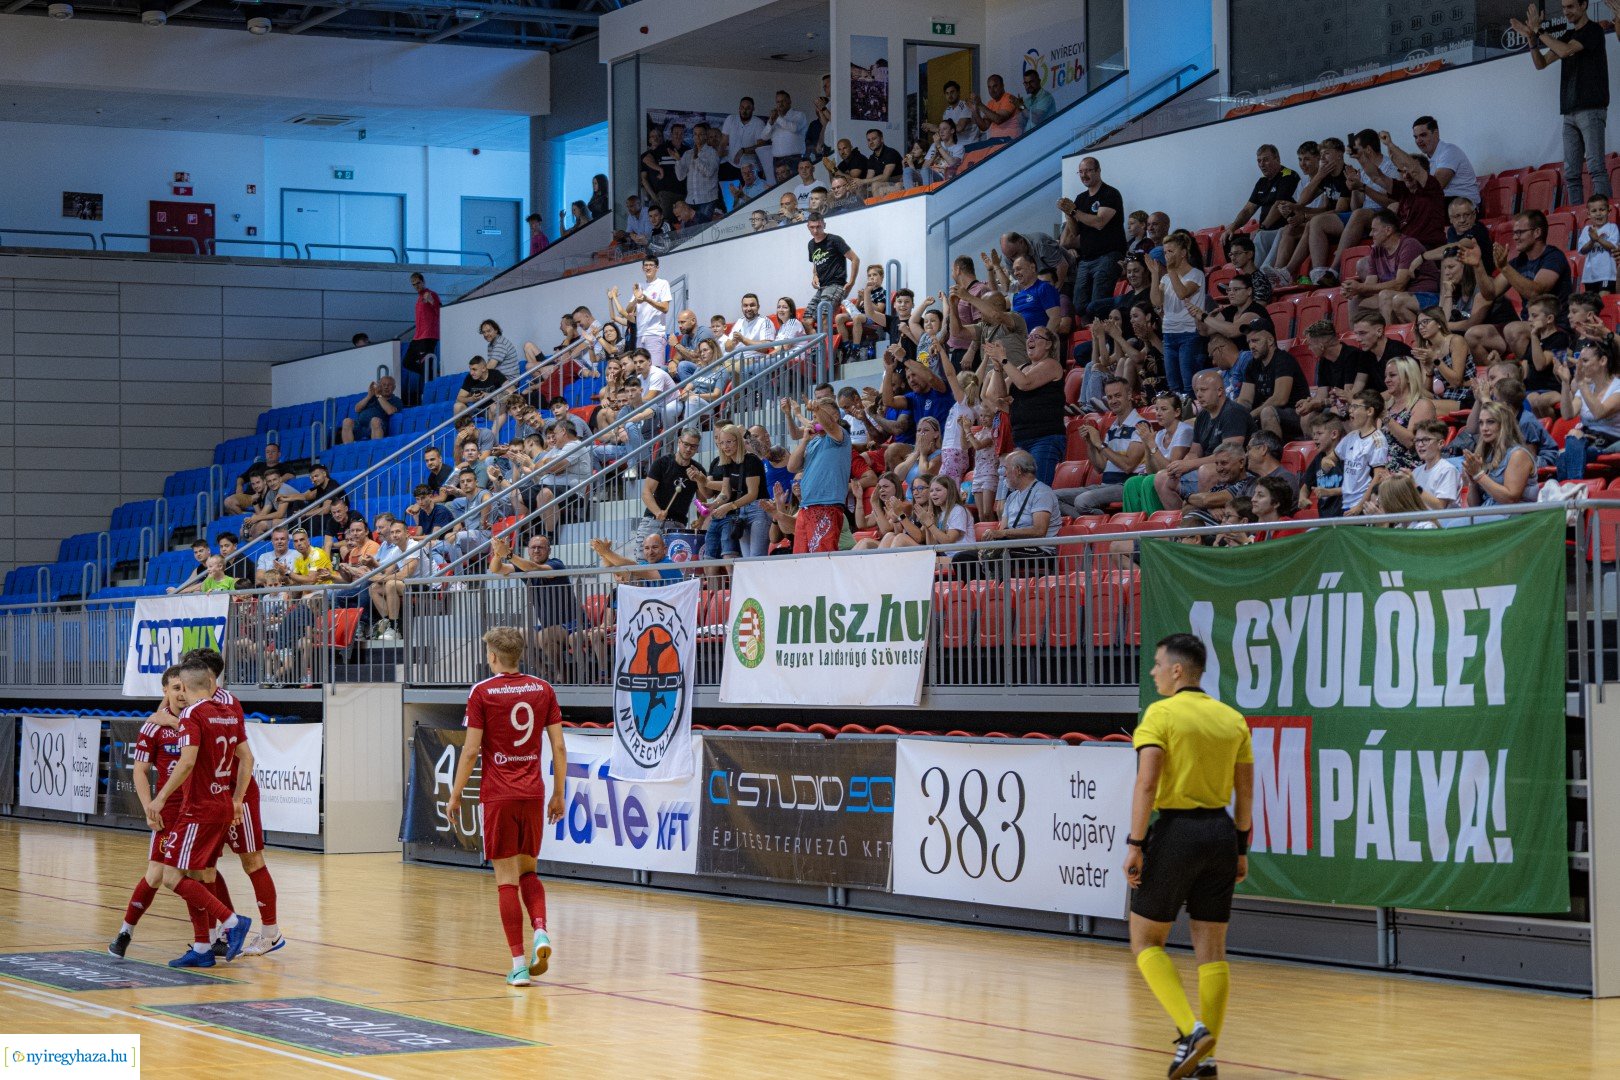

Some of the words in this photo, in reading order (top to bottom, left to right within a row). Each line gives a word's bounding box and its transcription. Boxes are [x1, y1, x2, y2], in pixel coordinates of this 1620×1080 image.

[776, 593, 930, 645] mlsz.hu
[1232, 571, 1517, 709] GYŰLÖLET
[775, 649, 814, 669] Magyar
[510, 701, 535, 747] 9
[30, 731, 67, 797] 383
[78, 732, 88, 749] the
[73, 785, 92, 798] water
[846, 776, 896, 813] 90
[1318, 729, 1514, 864] PÁLYA!
[656, 811, 689, 852] KFT
[920, 766, 1026, 883] 383
[1069, 770, 1097, 800] the
[1058, 862, 1109, 889] water
